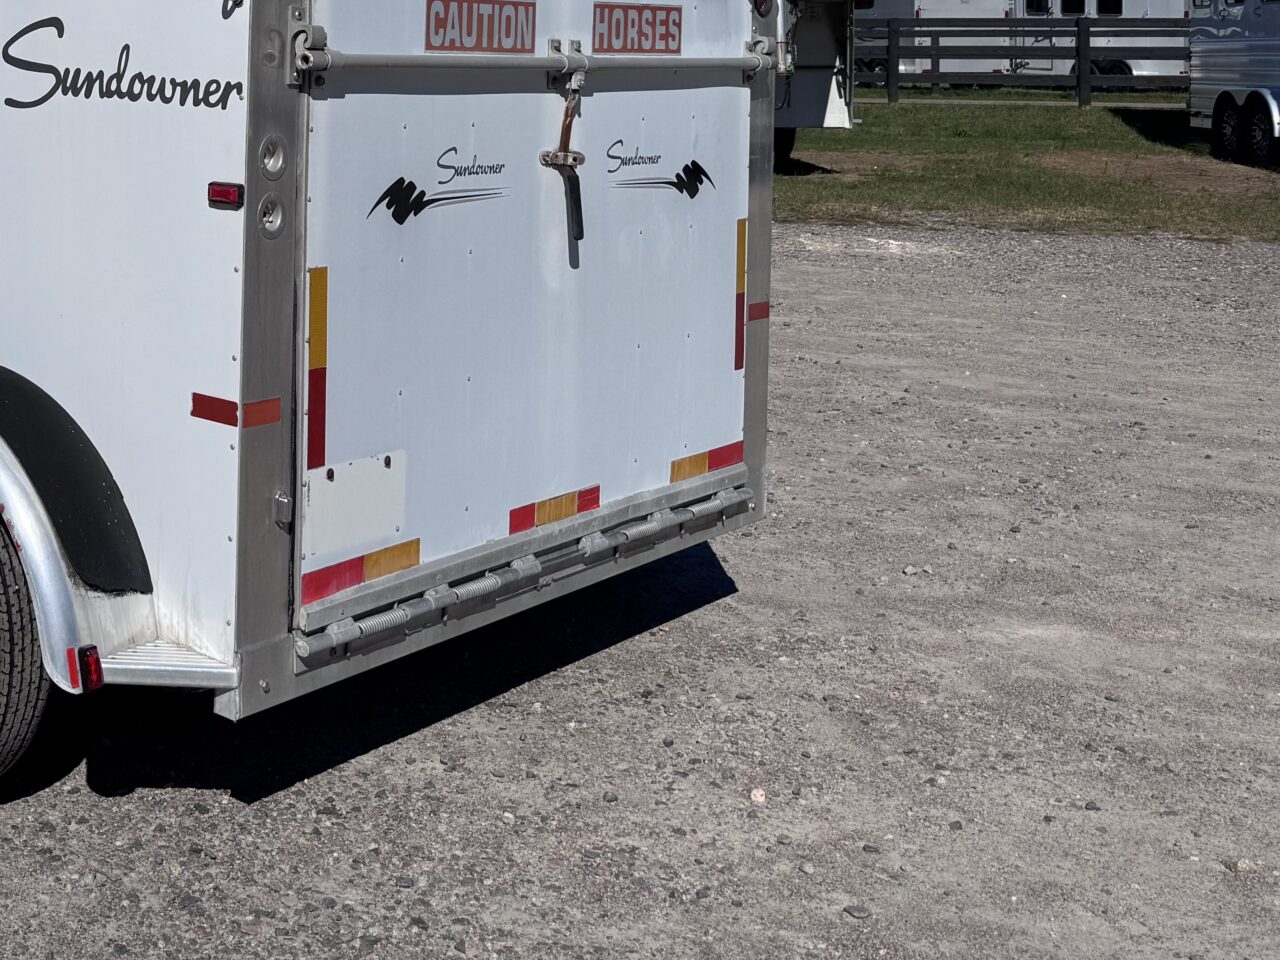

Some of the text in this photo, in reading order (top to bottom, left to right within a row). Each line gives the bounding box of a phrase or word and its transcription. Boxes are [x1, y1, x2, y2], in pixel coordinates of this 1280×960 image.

[429, 0, 533, 50] CAUTION
[594, 7, 680, 51] HORSES
[2, 16, 243, 110] Sundowner
[436, 146, 506, 185] Sundowner
[606, 139, 662, 174] Sundowner
